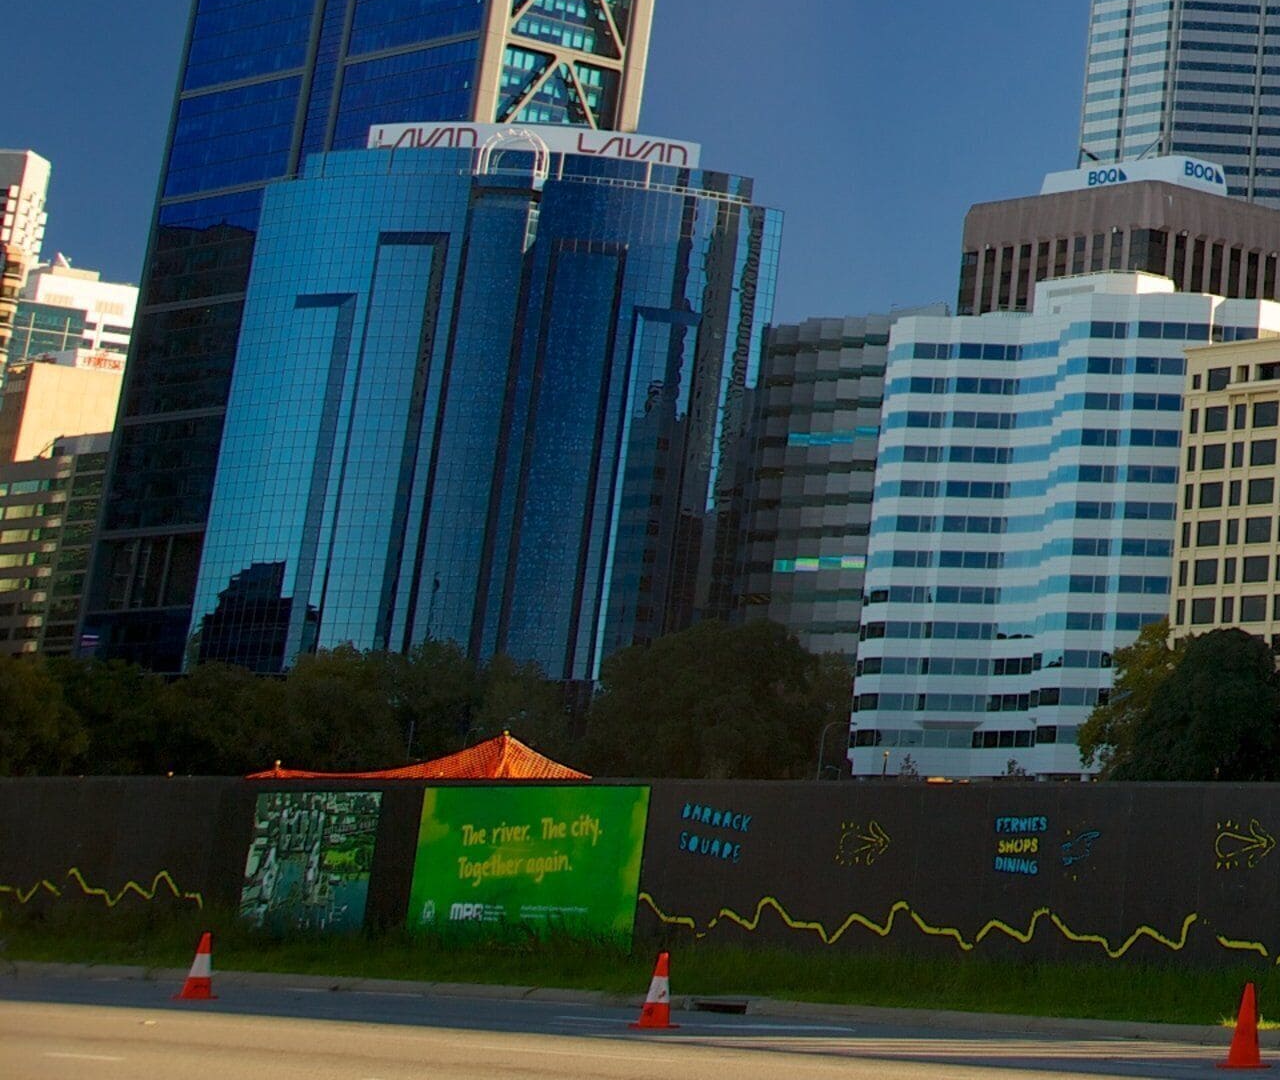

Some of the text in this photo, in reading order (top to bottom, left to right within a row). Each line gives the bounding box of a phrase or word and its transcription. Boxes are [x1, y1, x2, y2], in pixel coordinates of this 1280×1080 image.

[1088, 169, 1117, 185] BOQ
[1185, 161, 1214, 181] BOQ
[682, 803, 752, 832] BARRACK
[996, 817, 1048, 832] FERRIES
[462, 815, 603, 846] The river. The city.
[679, 832, 741, 863] SQUARE
[998, 839, 1038, 853] SHOPS
[458, 851, 573, 887] Together again.
[995, 857, 1038, 874] DINING
